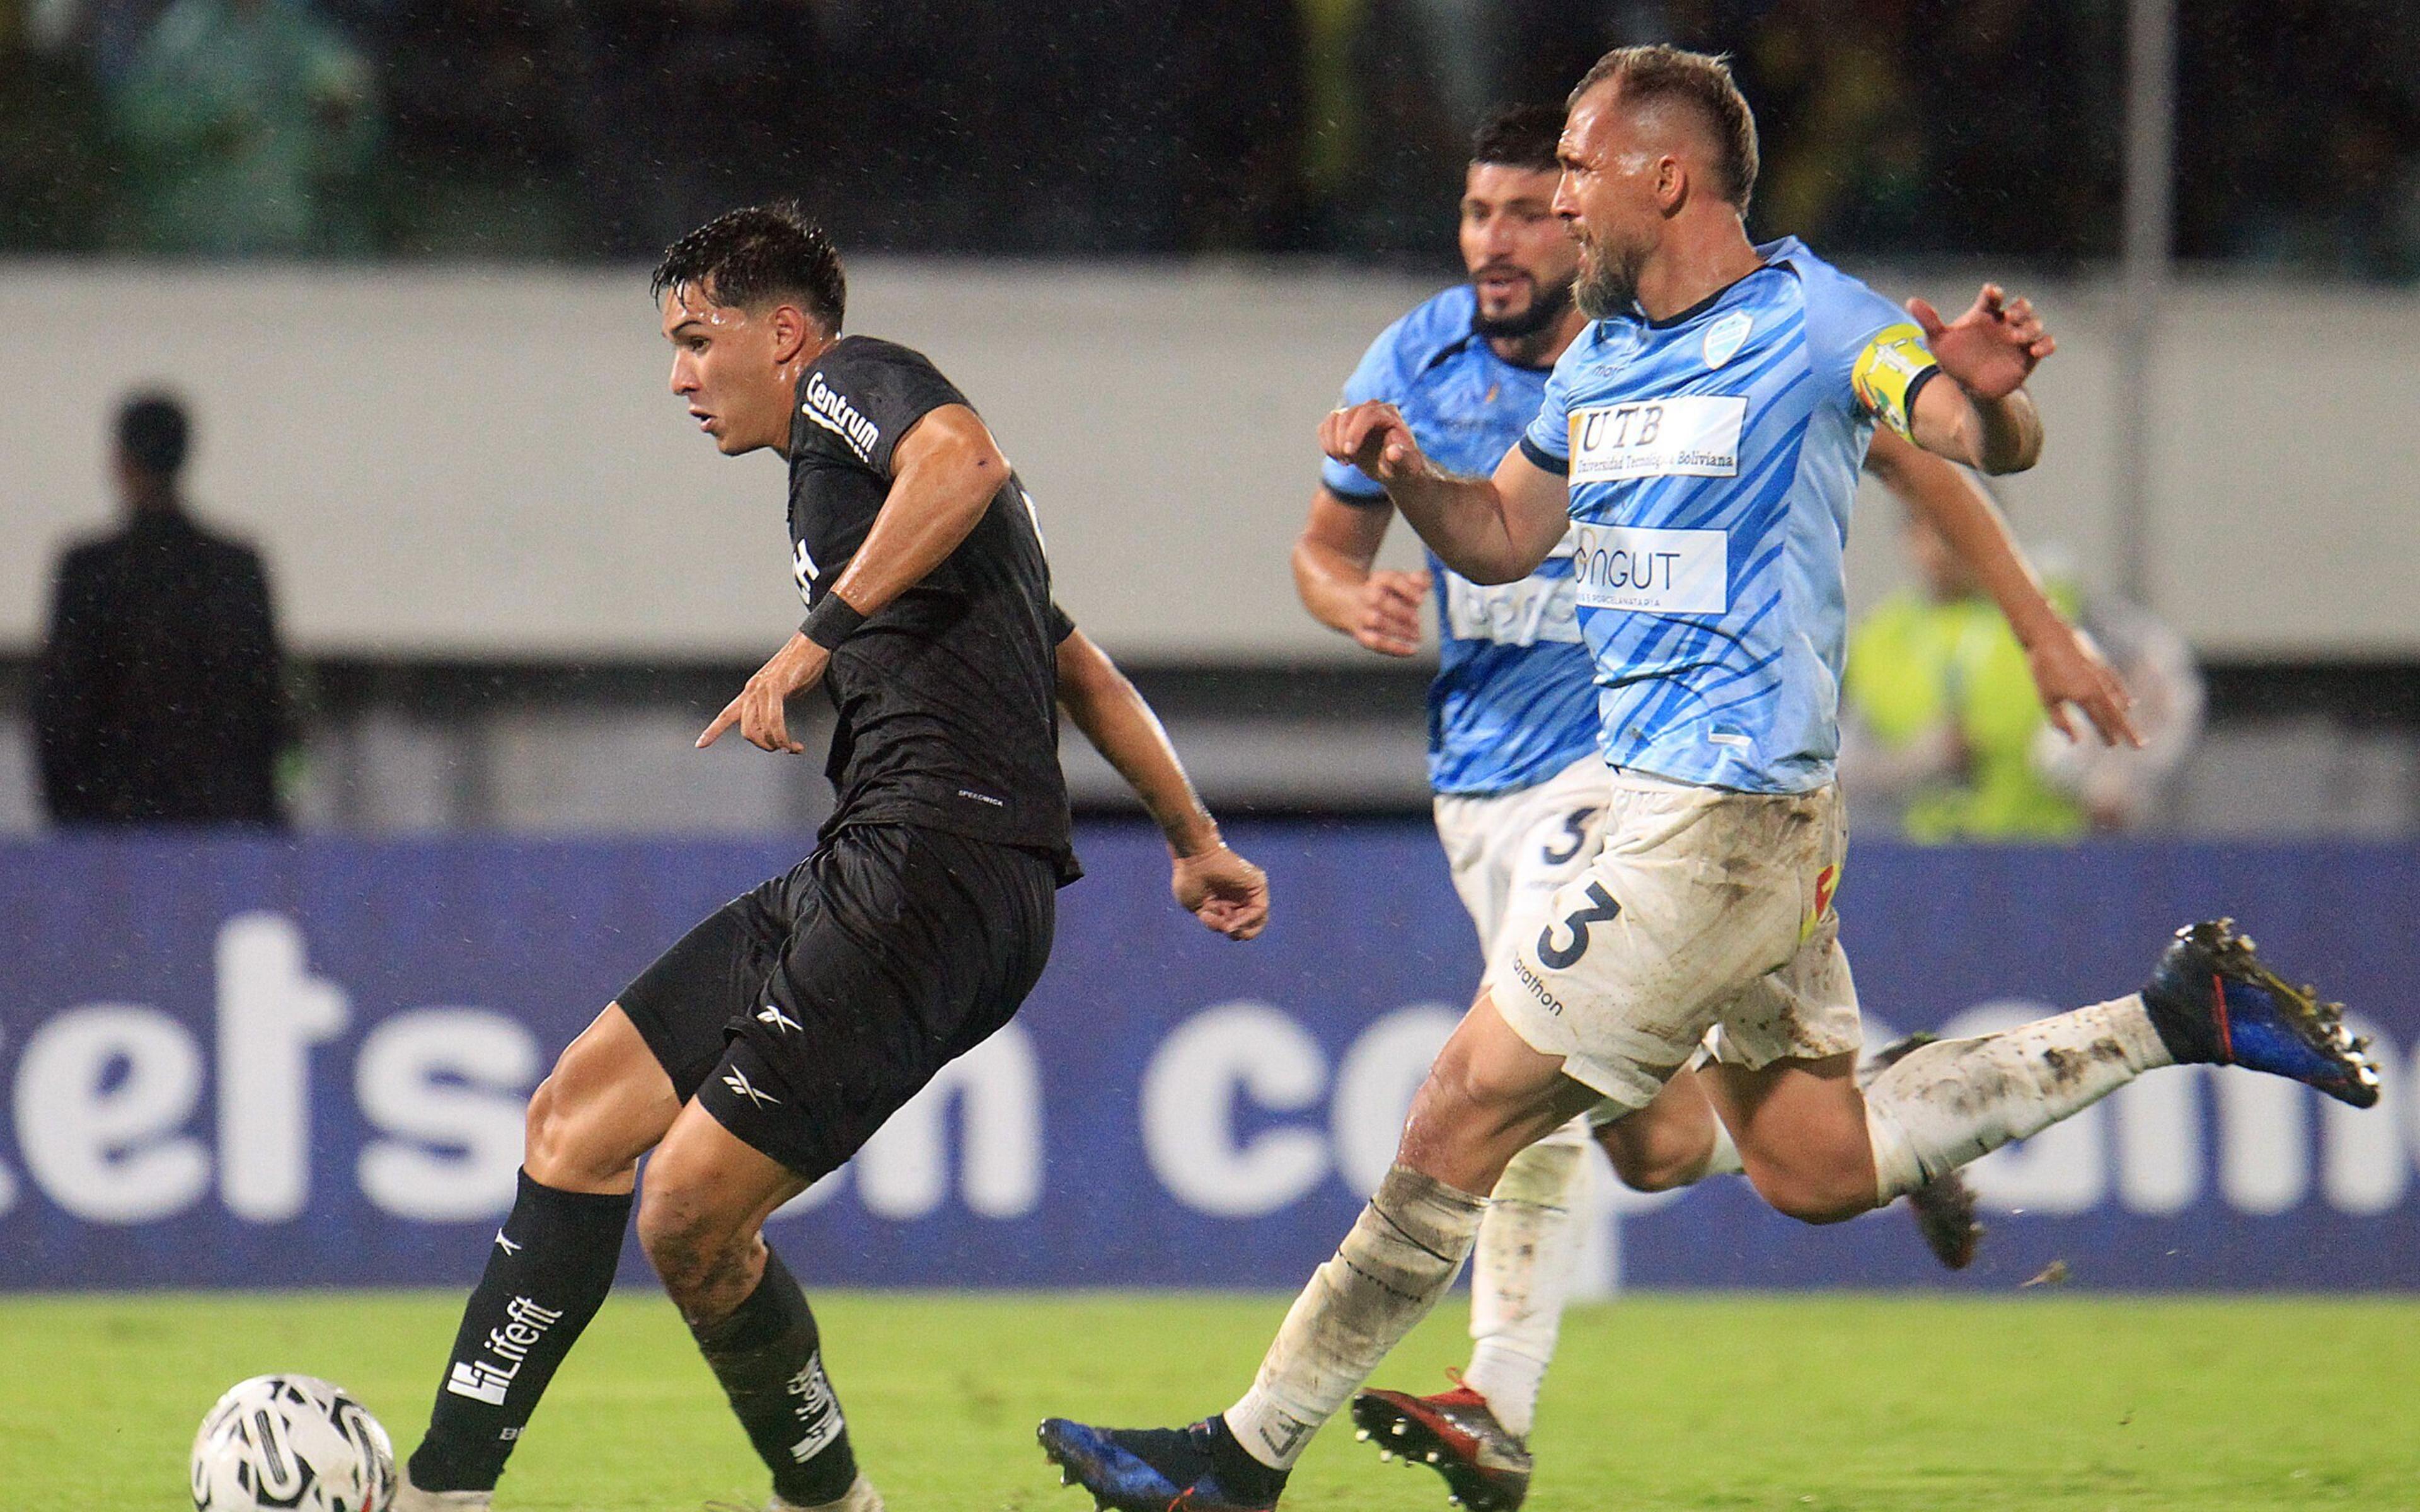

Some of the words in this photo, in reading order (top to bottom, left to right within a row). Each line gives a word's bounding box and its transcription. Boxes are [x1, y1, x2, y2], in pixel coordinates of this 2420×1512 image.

[806, 371, 879, 453] Centrum
[1582, 406, 1664, 452] UTB
[1677, 450, 1733, 467] Boliviana
[793, 538, 820, 605] H
[1543, 808, 1597, 865] 3
[1536, 880, 1622, 970] 3
[0, 909, 542, 1225] ets
